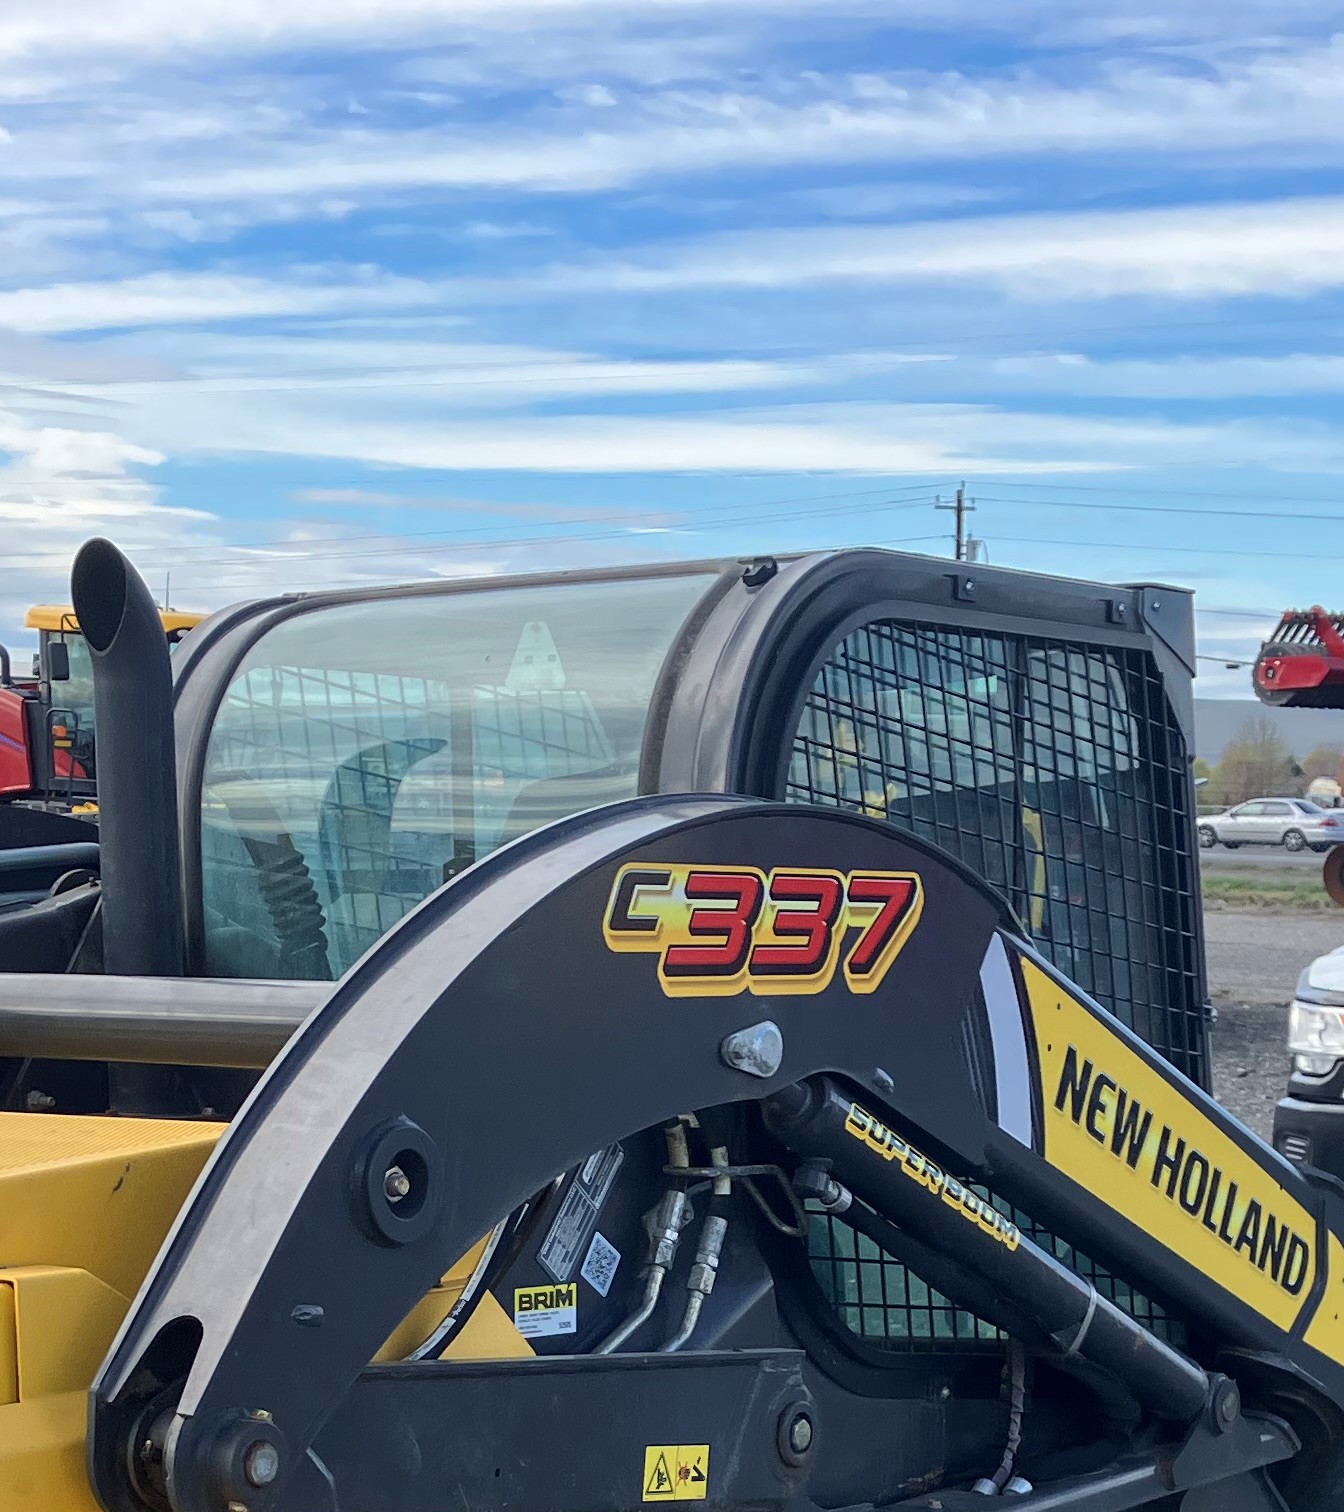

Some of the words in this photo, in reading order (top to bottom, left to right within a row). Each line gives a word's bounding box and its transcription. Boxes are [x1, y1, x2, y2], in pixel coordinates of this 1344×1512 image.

[604, 863, 923, 997] C337
[845, 1102, 944, 1194] SUPER
[941, 1172, 1021, 1252] BOOM
[1054, 1044, 1154, 1170] NEW
[1150, 1123, 1309, 1297] HOLLAND
[518, 1286, 574, 1311] BRIM
